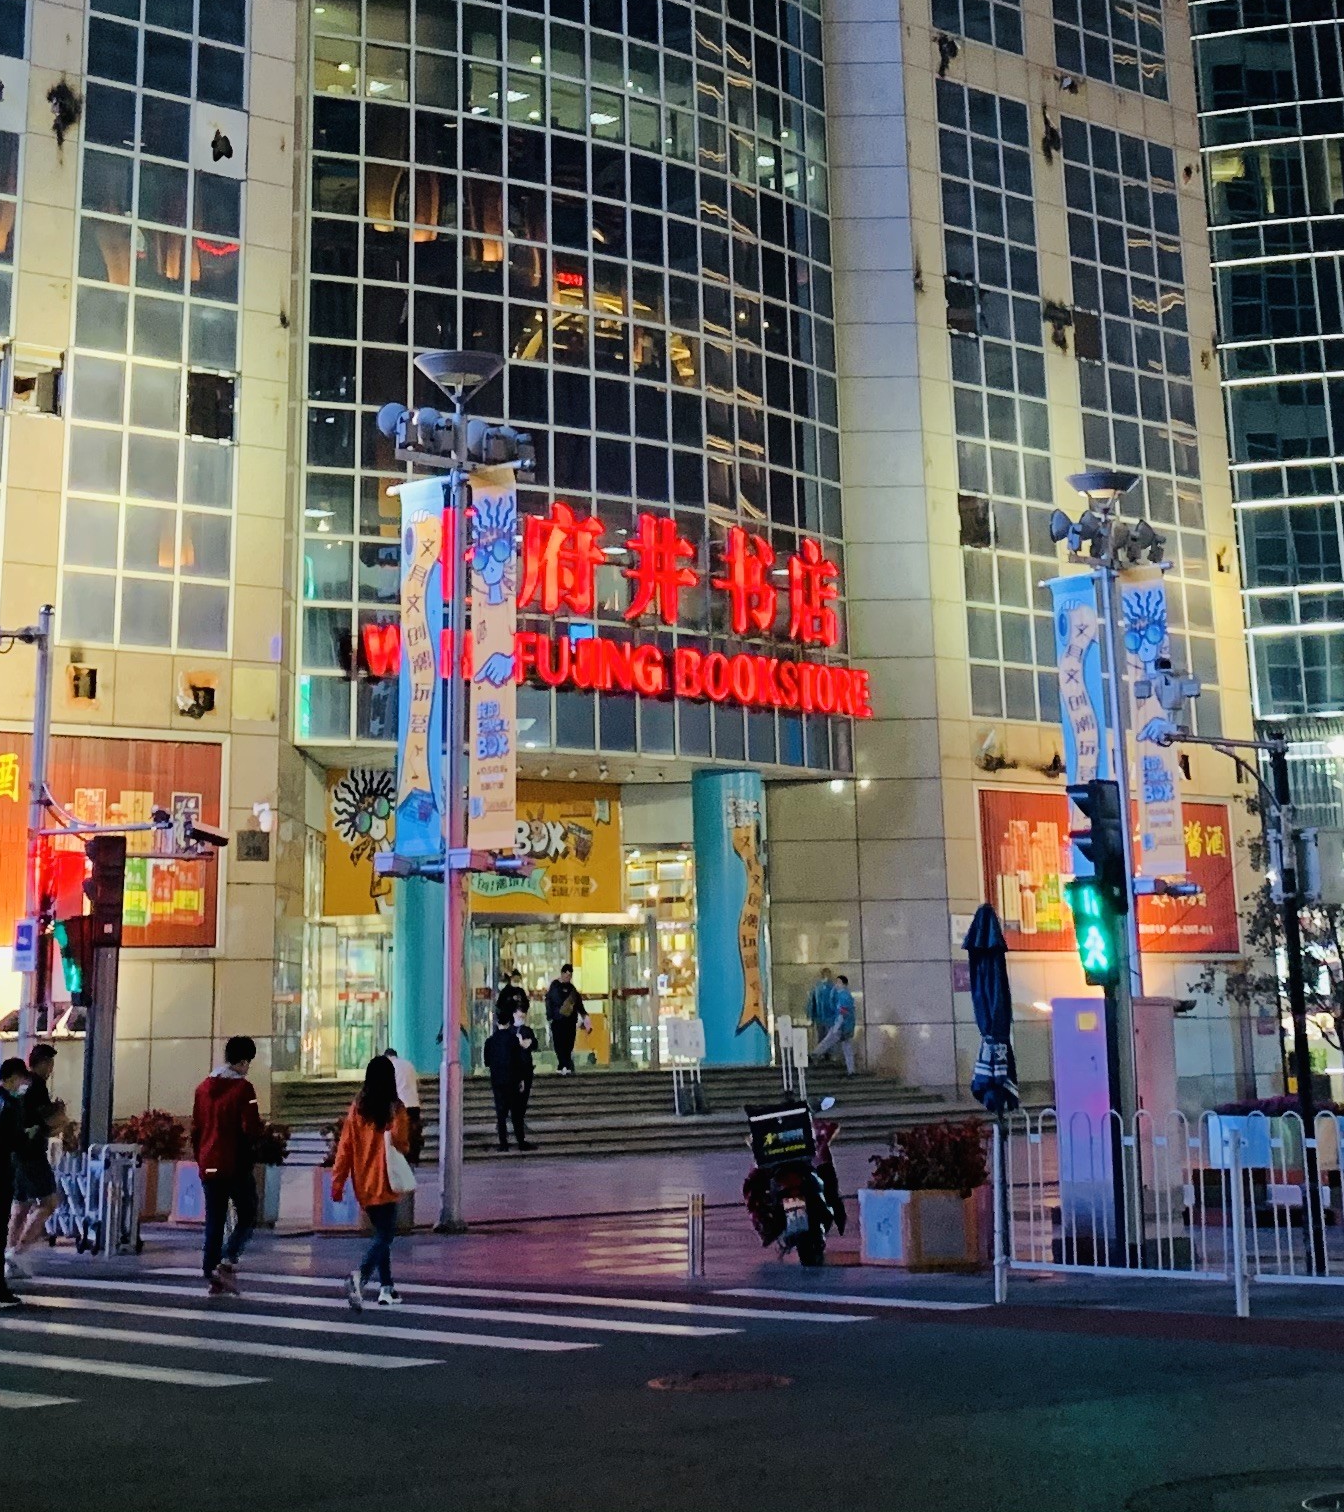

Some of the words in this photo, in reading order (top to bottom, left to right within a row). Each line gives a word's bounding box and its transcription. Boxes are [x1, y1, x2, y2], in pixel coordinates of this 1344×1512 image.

[441, 500, 840, 648] 府井书店
[674, 648, 876, 719] BOOKSTORE
[513, 819, 569, 862] BOX
